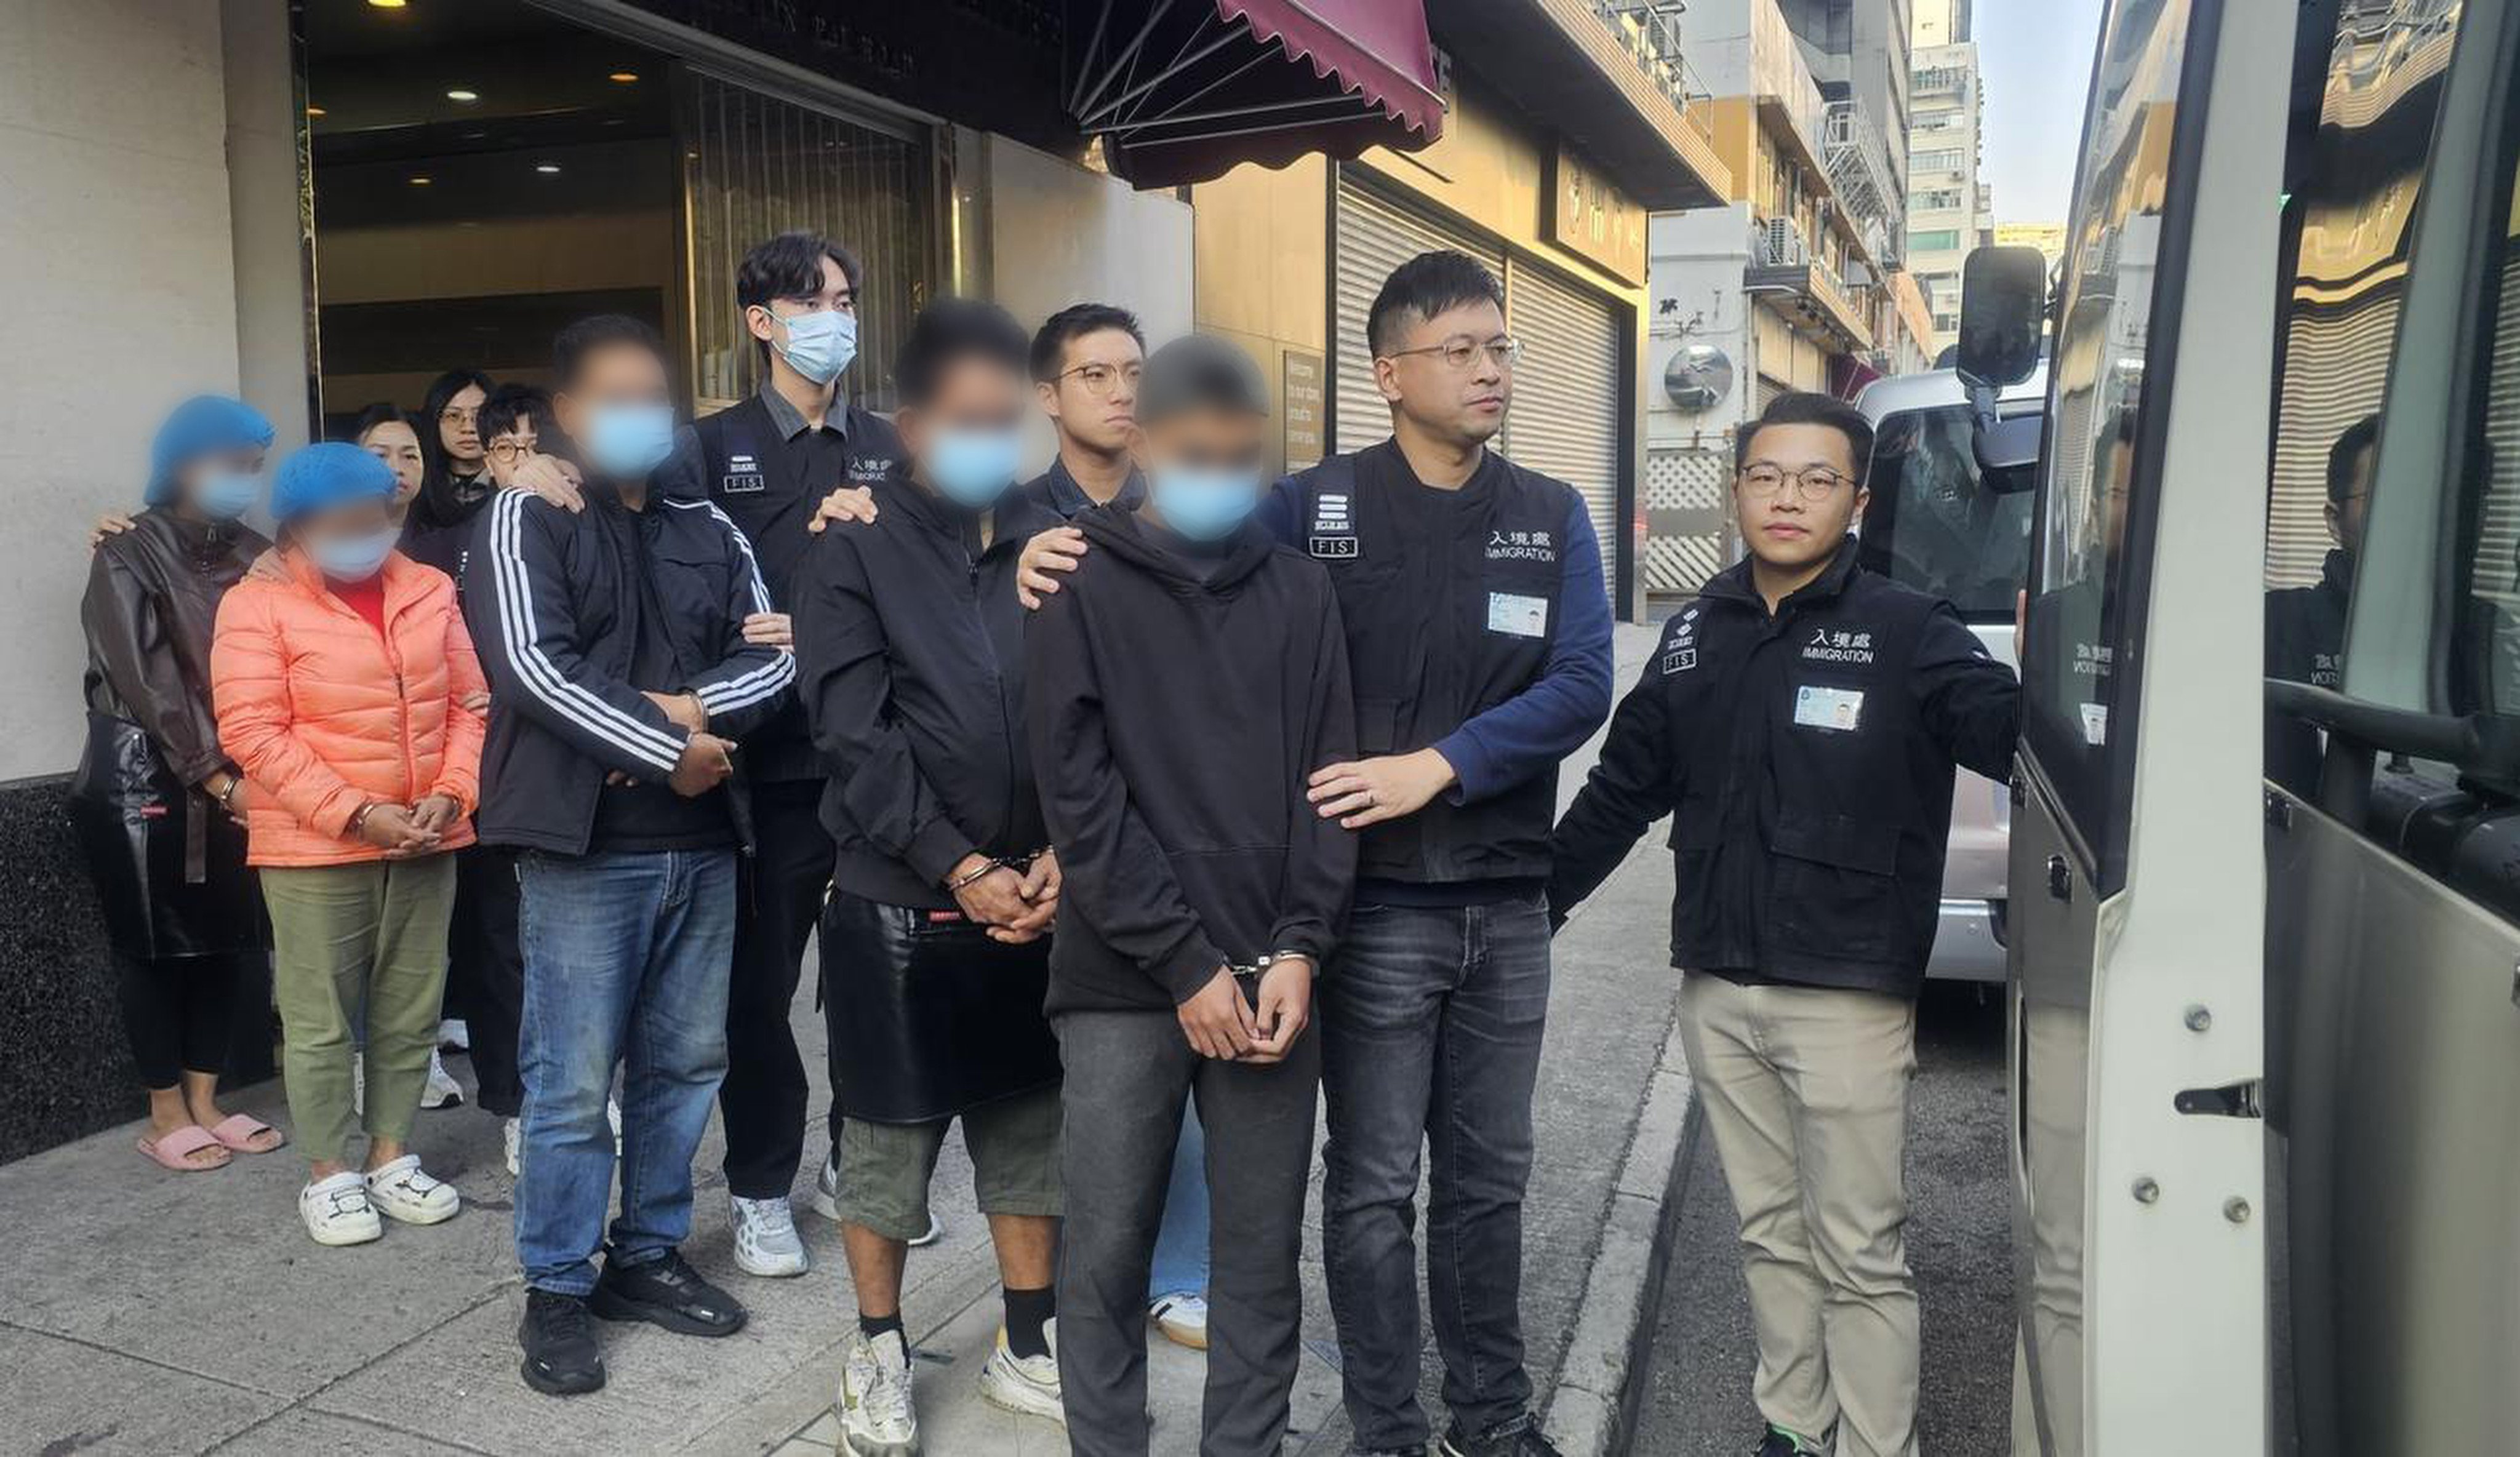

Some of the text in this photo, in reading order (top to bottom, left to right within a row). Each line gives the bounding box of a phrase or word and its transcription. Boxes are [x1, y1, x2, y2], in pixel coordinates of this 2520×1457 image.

[1489, 530, 1551, 546] 入境處
[1318, 541, 1348, 553] FIS
[1484, 546, 1556, 562] IMMIGRATION
[1810, 628, 1871, 648] 入境處
[1668, 654, 1688, 668] FIS
[1802, 647, 1874, 663] IMMIGRATION
